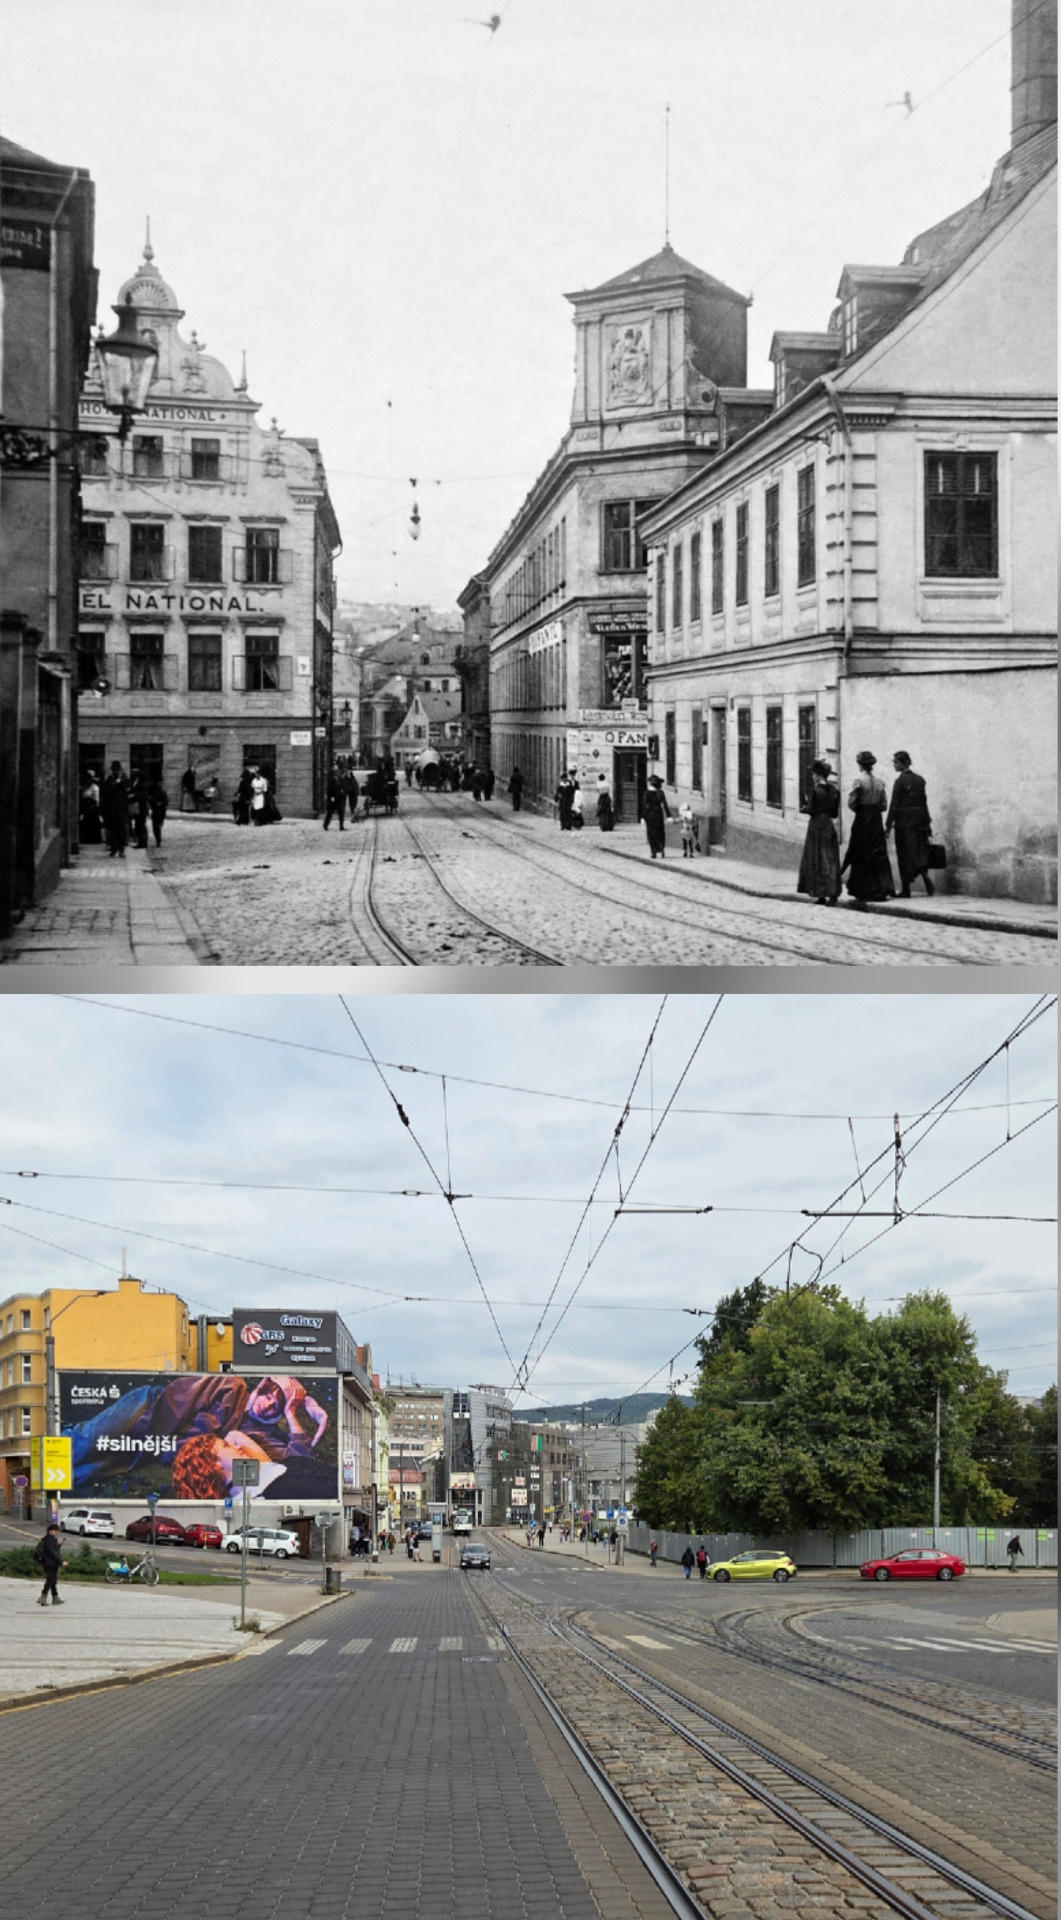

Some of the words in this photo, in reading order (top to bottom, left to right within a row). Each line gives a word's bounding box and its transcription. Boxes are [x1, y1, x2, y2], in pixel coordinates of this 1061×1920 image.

[280, 1314, 323, 1329] Galaxy
[71, 1385, 108, 1398] ČESKÁ
[96, 1435, 178, 1457] #silnější
